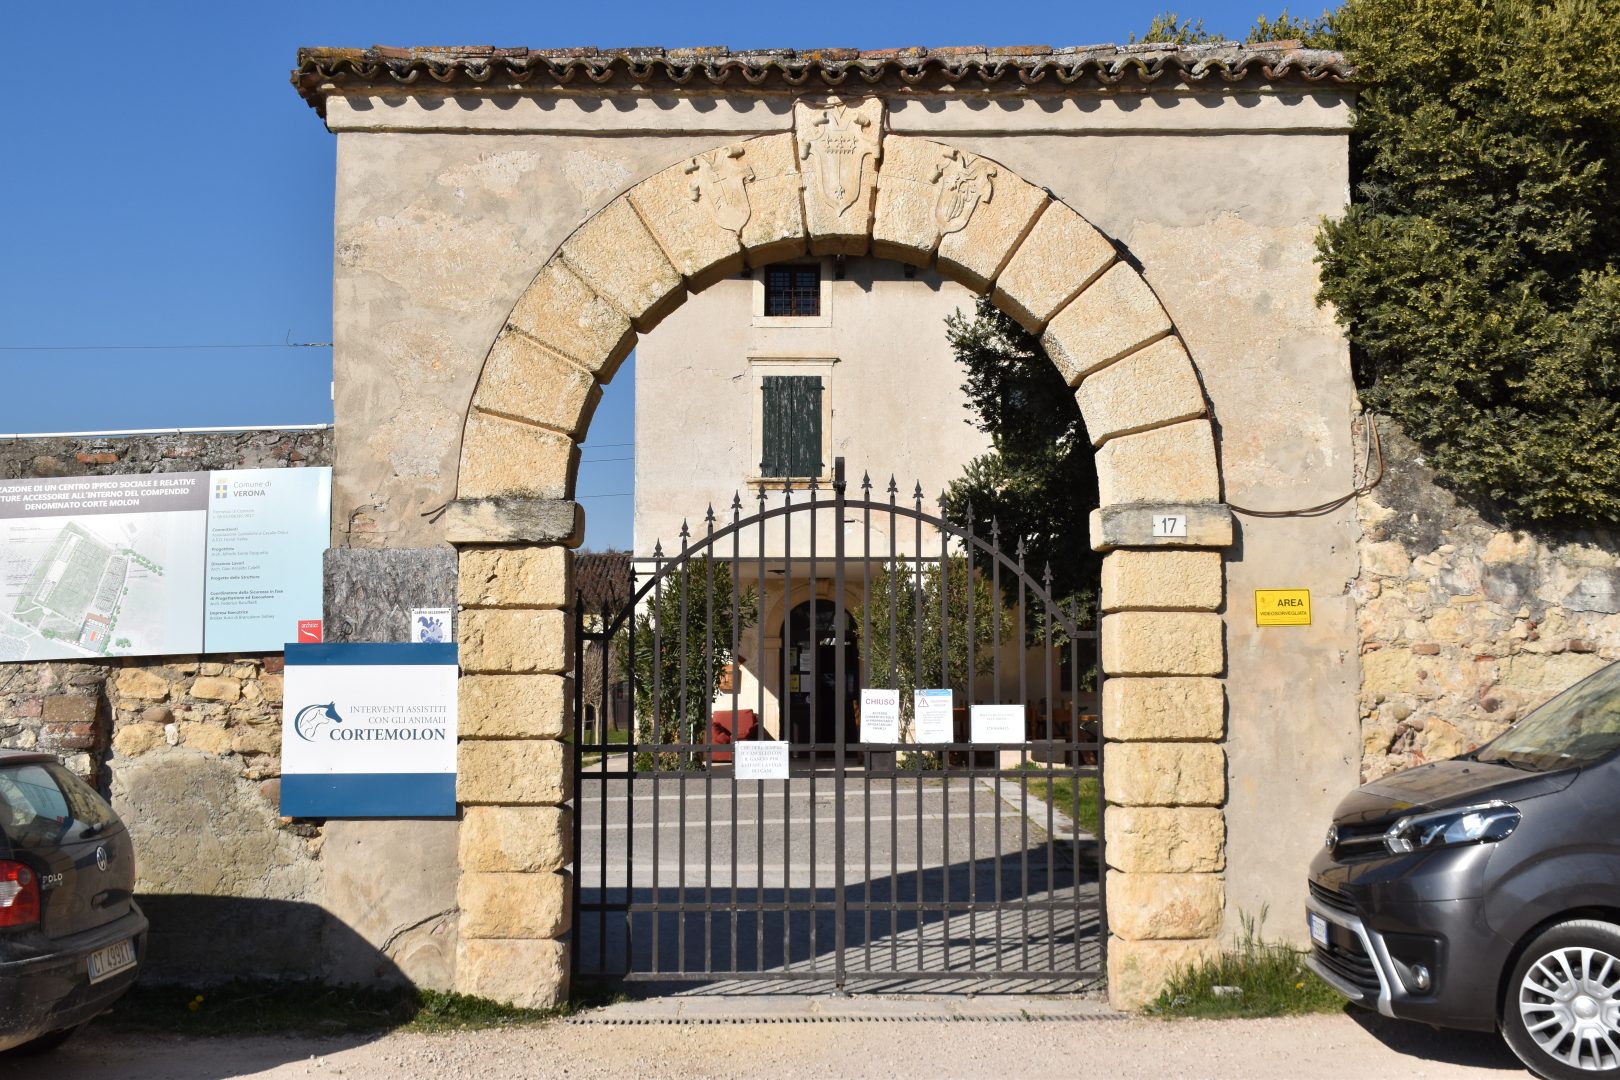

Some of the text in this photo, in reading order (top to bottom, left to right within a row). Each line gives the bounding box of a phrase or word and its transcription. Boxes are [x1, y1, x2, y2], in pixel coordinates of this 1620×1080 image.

[44, 484, 57, 492] UN
[58, 483, 90, 491] CENTRO
[91, 482, 118, 490] IPPICO
[119, 480, 152, 489] SOCIALE
[160, 478, 196, 487] RELATIVE
[233, 481, 263, 489] Comune
[22, 492, 70, 502] ACCESSORIE
[71, 490, 123, 500] ALL'INTERNO
[125, 489, 139, 497] DEL
[140, 487, 190, 497] COMPENDIO
[233, 489, 266, 497] VERONA
[25, 499, 140, 511] DENOMINATO CORTE MOLON
[1162, 517, 1177, 533] 17
[1277, 598, 1304, 607] AREA
[350, 705, 446, 714] INTERVENTI ASSISTITI
[408, 716, 446, 724] ANIMALI
[329, 728, 446, 741] CORTEMOLON
[42, 873, 63, 884] POLO
[94, 941, 130, 974] CT 499XT
